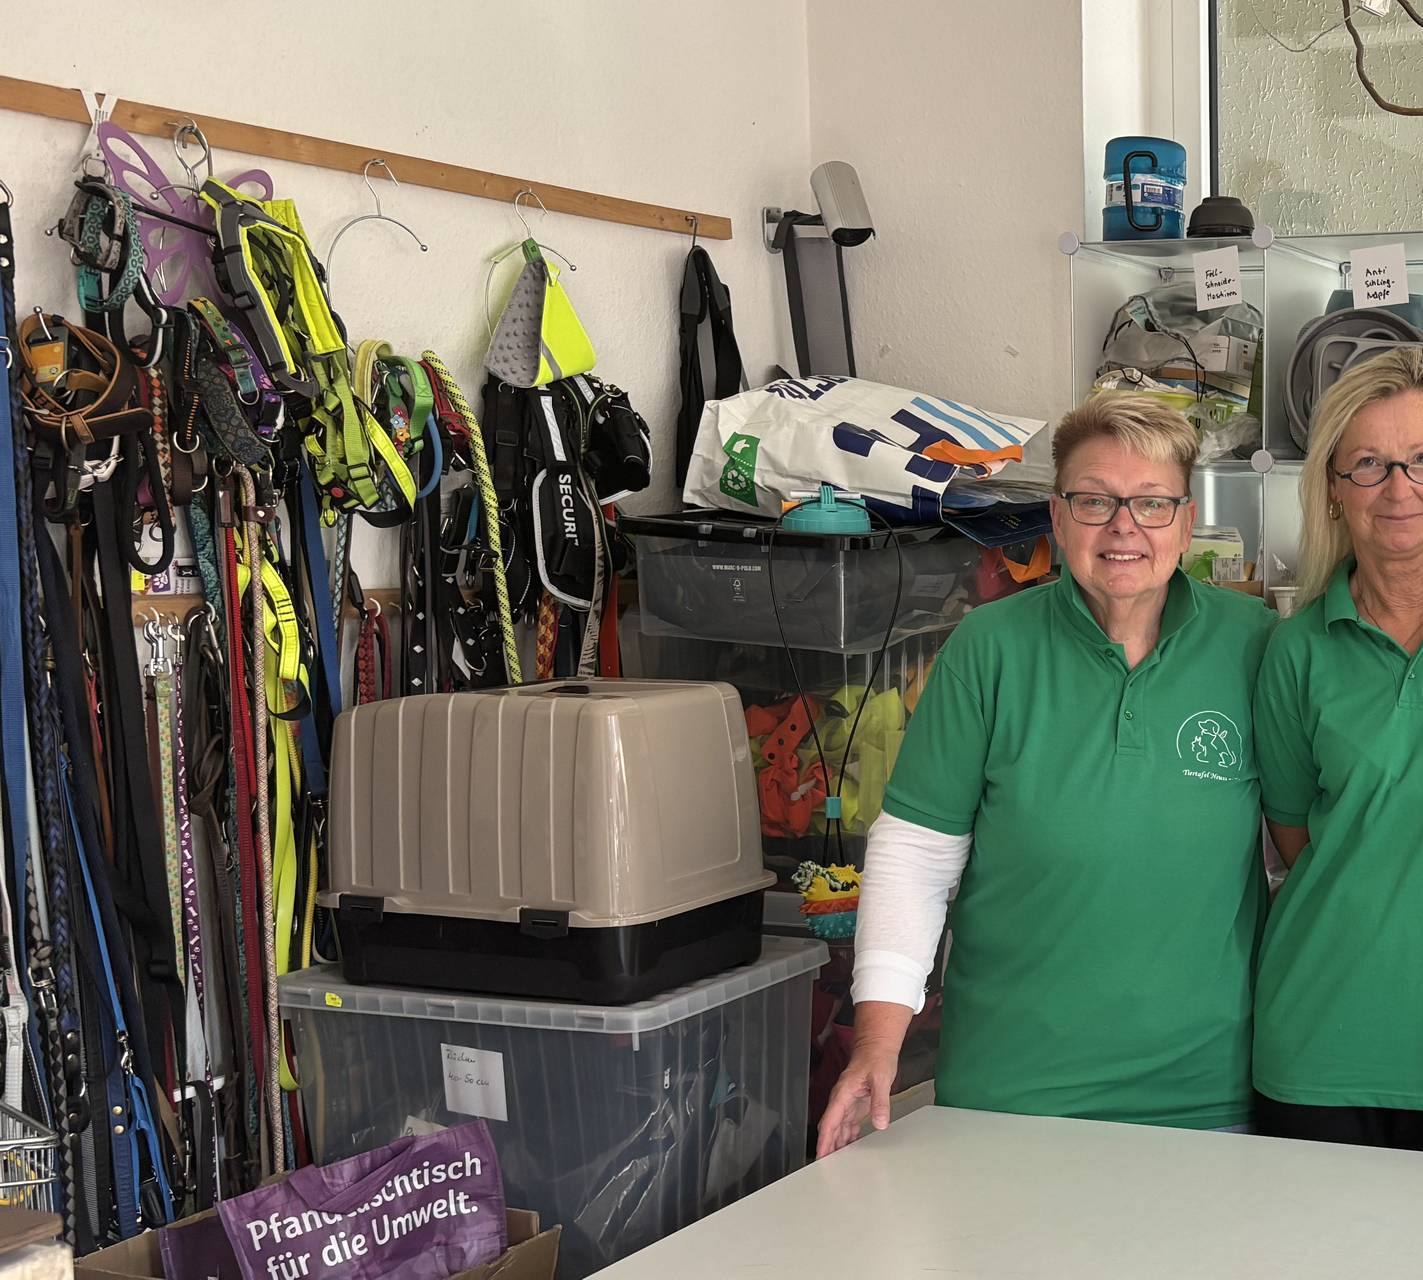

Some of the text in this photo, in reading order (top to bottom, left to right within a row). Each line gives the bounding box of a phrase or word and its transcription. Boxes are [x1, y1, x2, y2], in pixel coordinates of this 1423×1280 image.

[1365, 266, 1388, 277] Anti
[266, 1188, 480, 1280] für die Umwelt.
